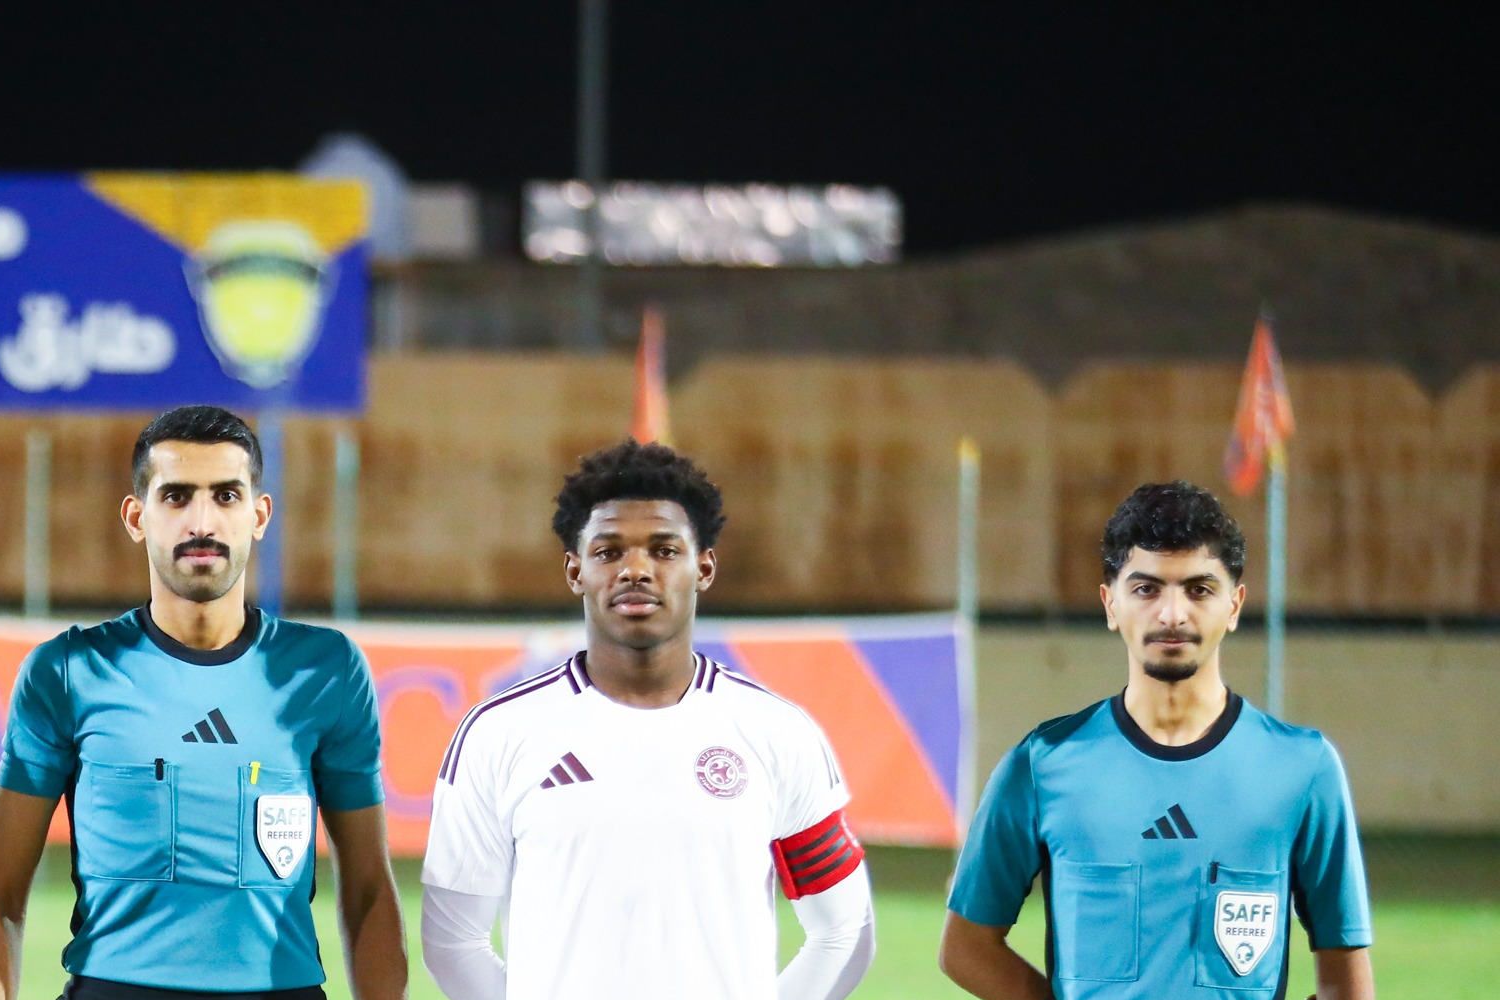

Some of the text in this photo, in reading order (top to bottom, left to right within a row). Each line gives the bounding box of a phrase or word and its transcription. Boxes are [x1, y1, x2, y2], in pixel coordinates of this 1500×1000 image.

[0, 292, 176, 392] طارق
[263, 807, 307, 826] SAFF
[267, 831, 302, 840] REFEREE
[1222, 903, 1272, 922] SAFF
[1225, 927, 1266, 937] REFEREE
